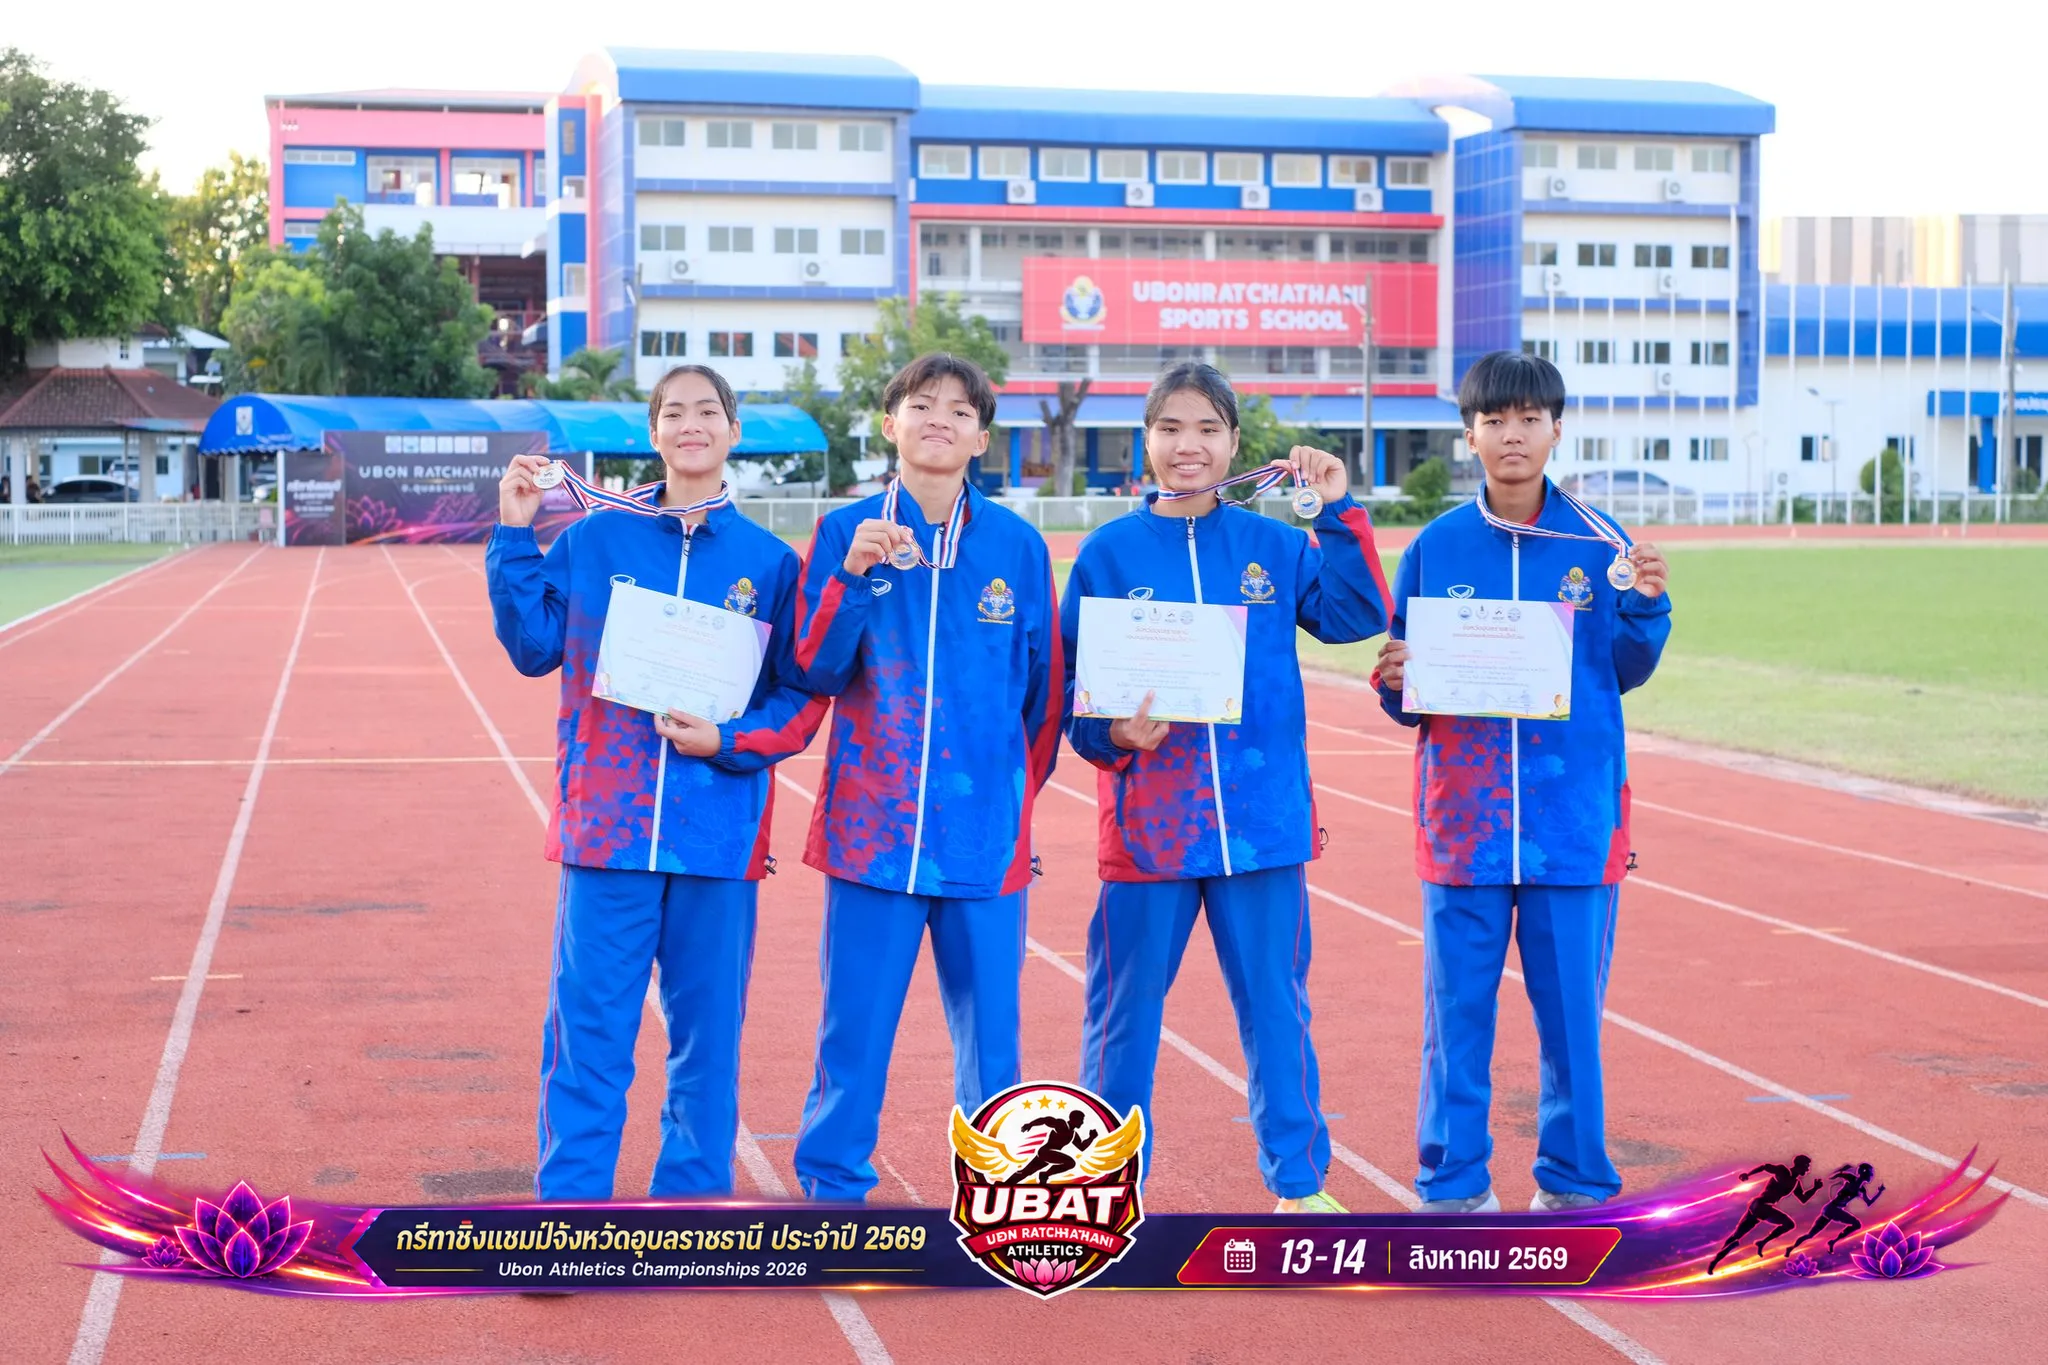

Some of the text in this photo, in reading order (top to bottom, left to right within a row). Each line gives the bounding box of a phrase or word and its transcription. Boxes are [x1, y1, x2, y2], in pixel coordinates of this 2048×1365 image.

[1132, 281, 1367, 305] UBONRATCHATHANI
[1159, 308, 1349, 331] SPORTS SCHOOL
[358, 465, 409, 479] UBON
